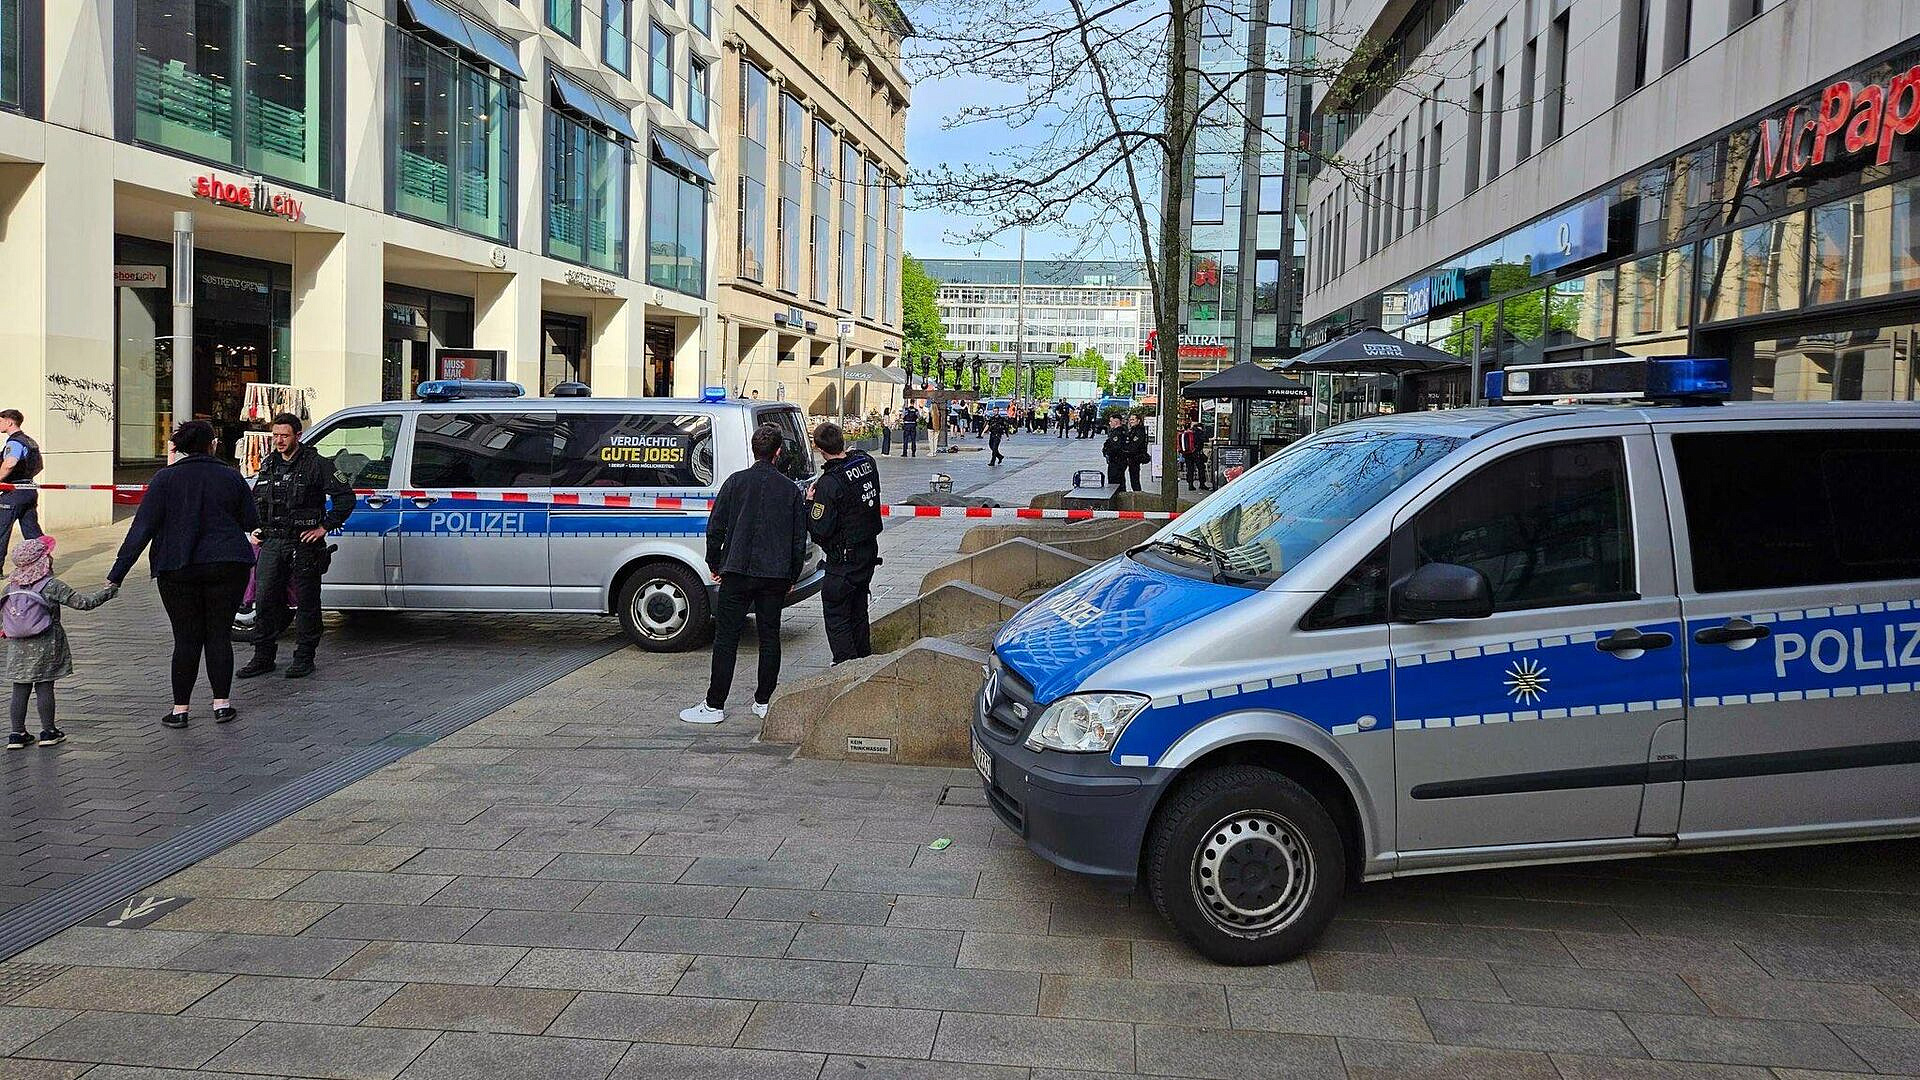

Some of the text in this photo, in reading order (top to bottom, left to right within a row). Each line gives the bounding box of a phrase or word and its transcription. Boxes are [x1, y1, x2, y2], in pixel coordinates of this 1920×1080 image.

[1751, 65, 1920, 187] McPap
[196, 173, 303, 221] shoe city
[143, 271, 157, 281] city
[1431, 269, 1458, 308] WERK
[1178, 334, 1224, 345] ENTRAL
[444, 360, 465, 369] MUSS
[845, 371, 872, 379] LUKAS
[610, 435, 677, 447] VERDÄCHTIG
[601, 447, 684, 462] GUTE JOBS!
[863, 481, 873, 492] SN
[431, 512, 525, 532] POLIZEI
[1774, 622, 1920, 678] POLIZ
